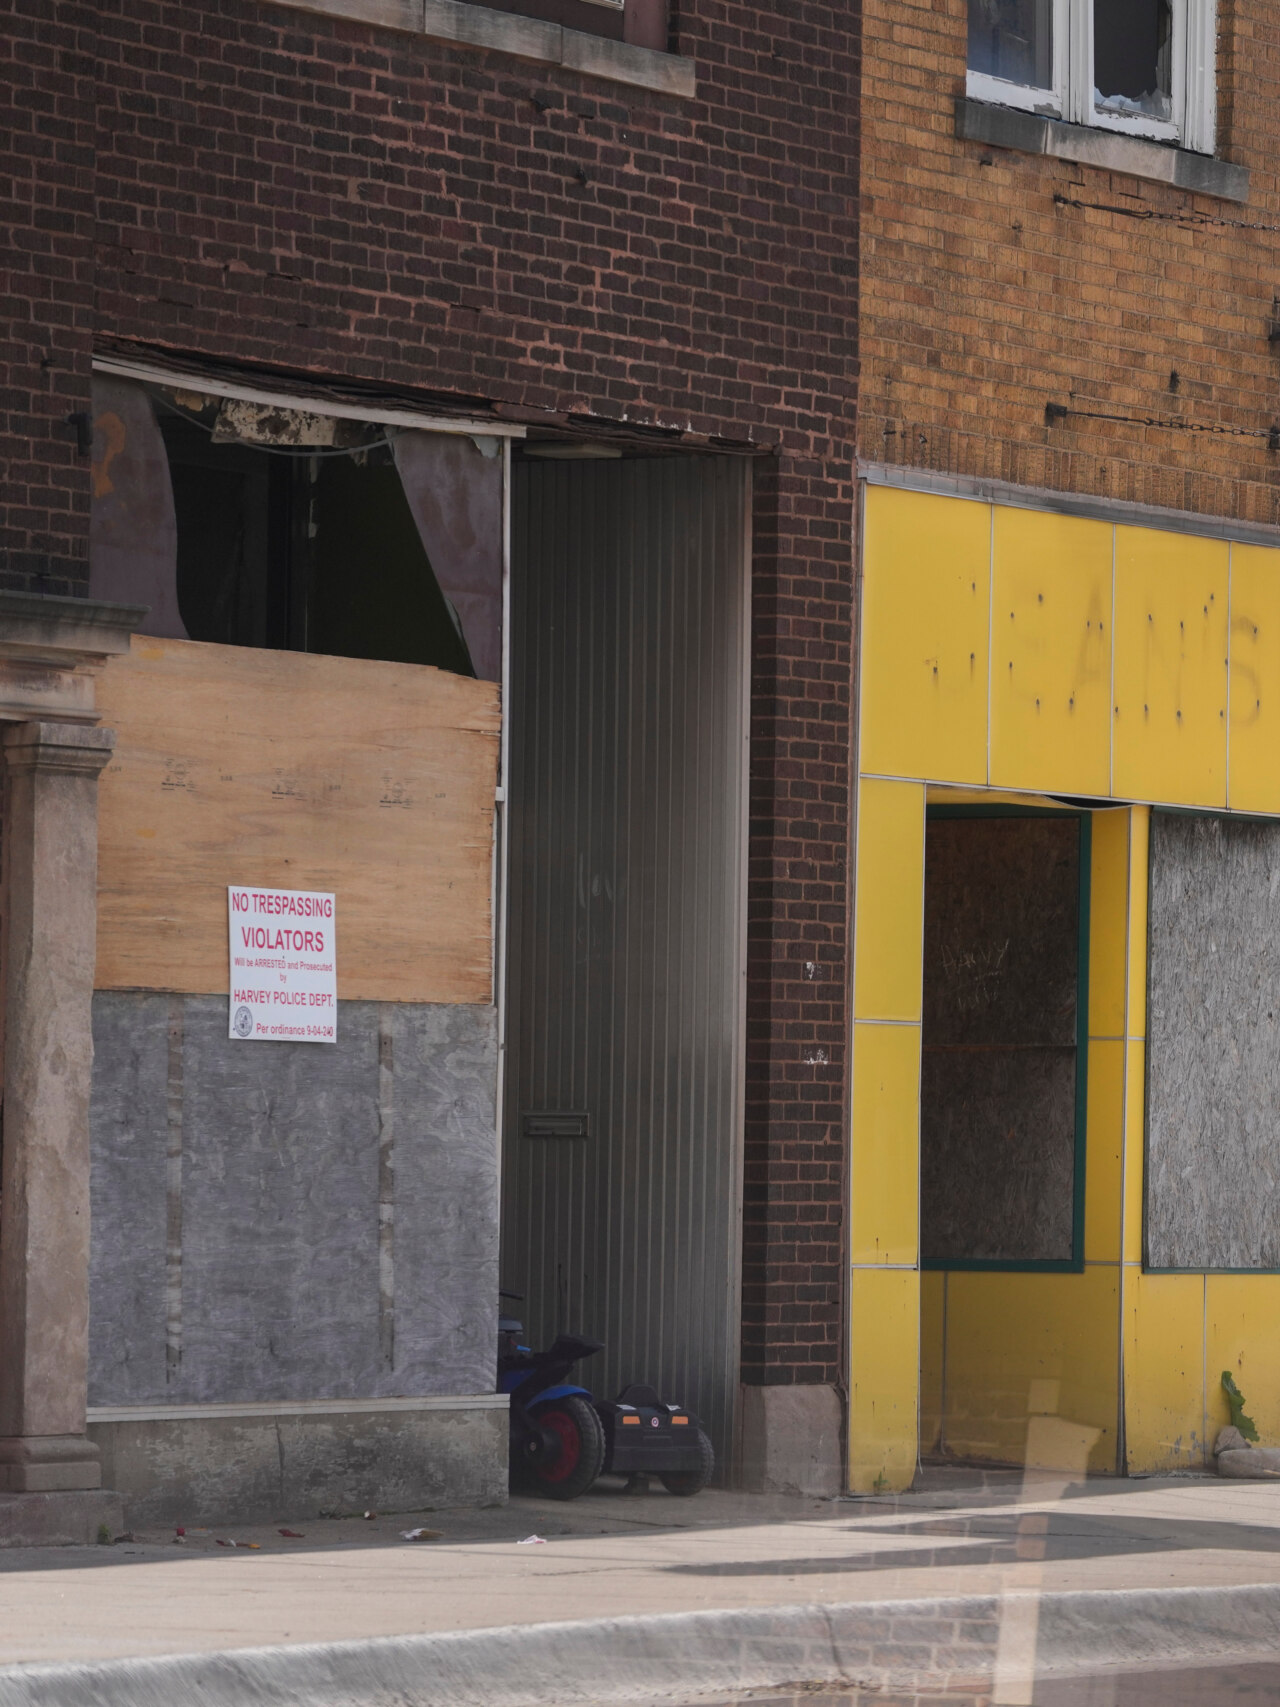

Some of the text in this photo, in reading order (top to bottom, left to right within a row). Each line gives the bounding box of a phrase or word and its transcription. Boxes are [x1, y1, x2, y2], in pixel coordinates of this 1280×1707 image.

[232, 892, 332, 918] NO TRESPASSING
[241, 926, 324, 952] VIOLATORS
[234, 957, 332, 972] Will be ARRESTED and Prosecuted
[279, 972, 287, 983] by
[233, 989, 334, 1008] HARVEY POLICE DEPT.
[256, 1023, 269, 1034] Per
[270, 1024, 305, 1036] ordinance
